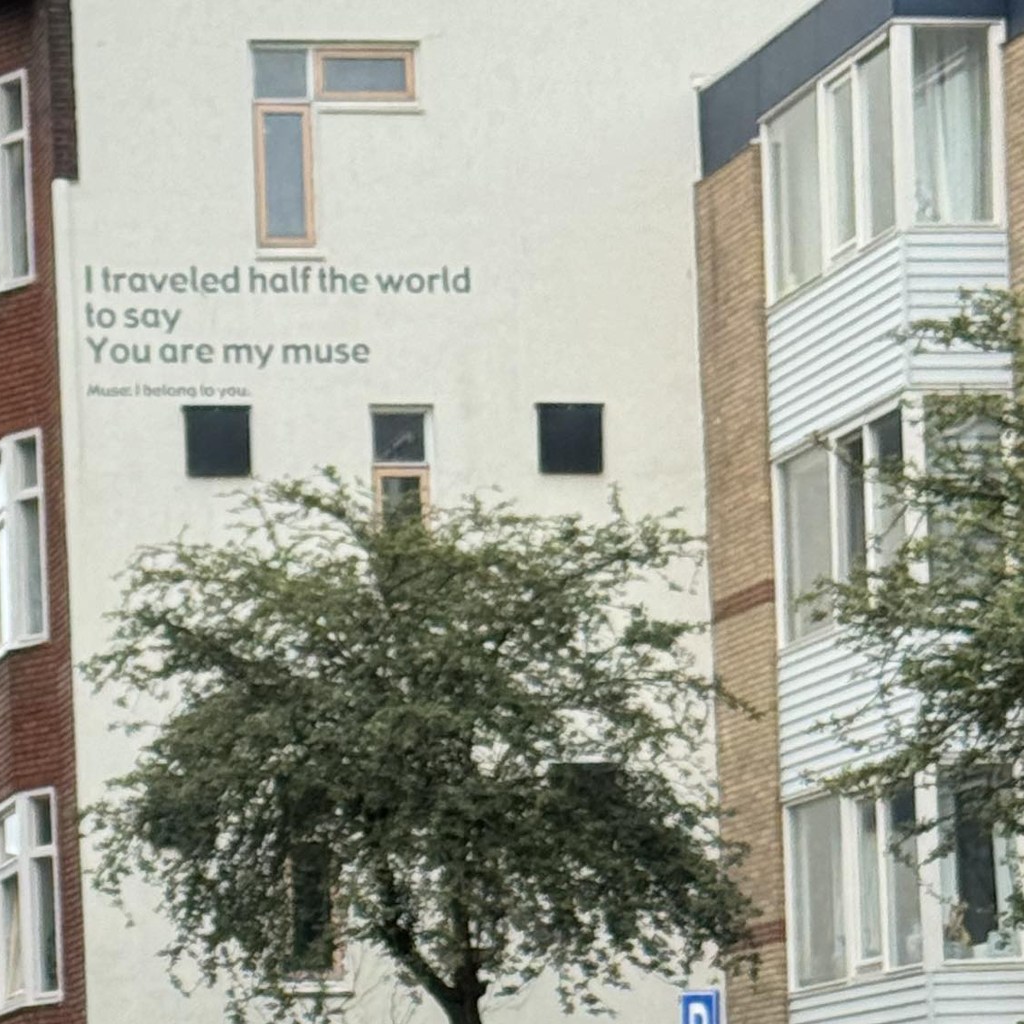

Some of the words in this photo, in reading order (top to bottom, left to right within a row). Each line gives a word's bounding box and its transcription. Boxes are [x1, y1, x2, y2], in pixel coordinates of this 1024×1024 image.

[85, 266, 92, 293] I
[102, 266, 240, 293] traveled
[249, 266, 312, 293] half
[318, 266, 369, 293] the
[375, 266, 471, 293] world
[85, 303, 116, 328] to
[124, 308, 181, 334] say
[86, 337, 150, 364] You
[159, 343, 214, 364] are
[223, 344, 274, 369] my
[282, 344, 370, 364] muse
[143, 384, 198, 399] belong
[200, 384, 215, 397] to
